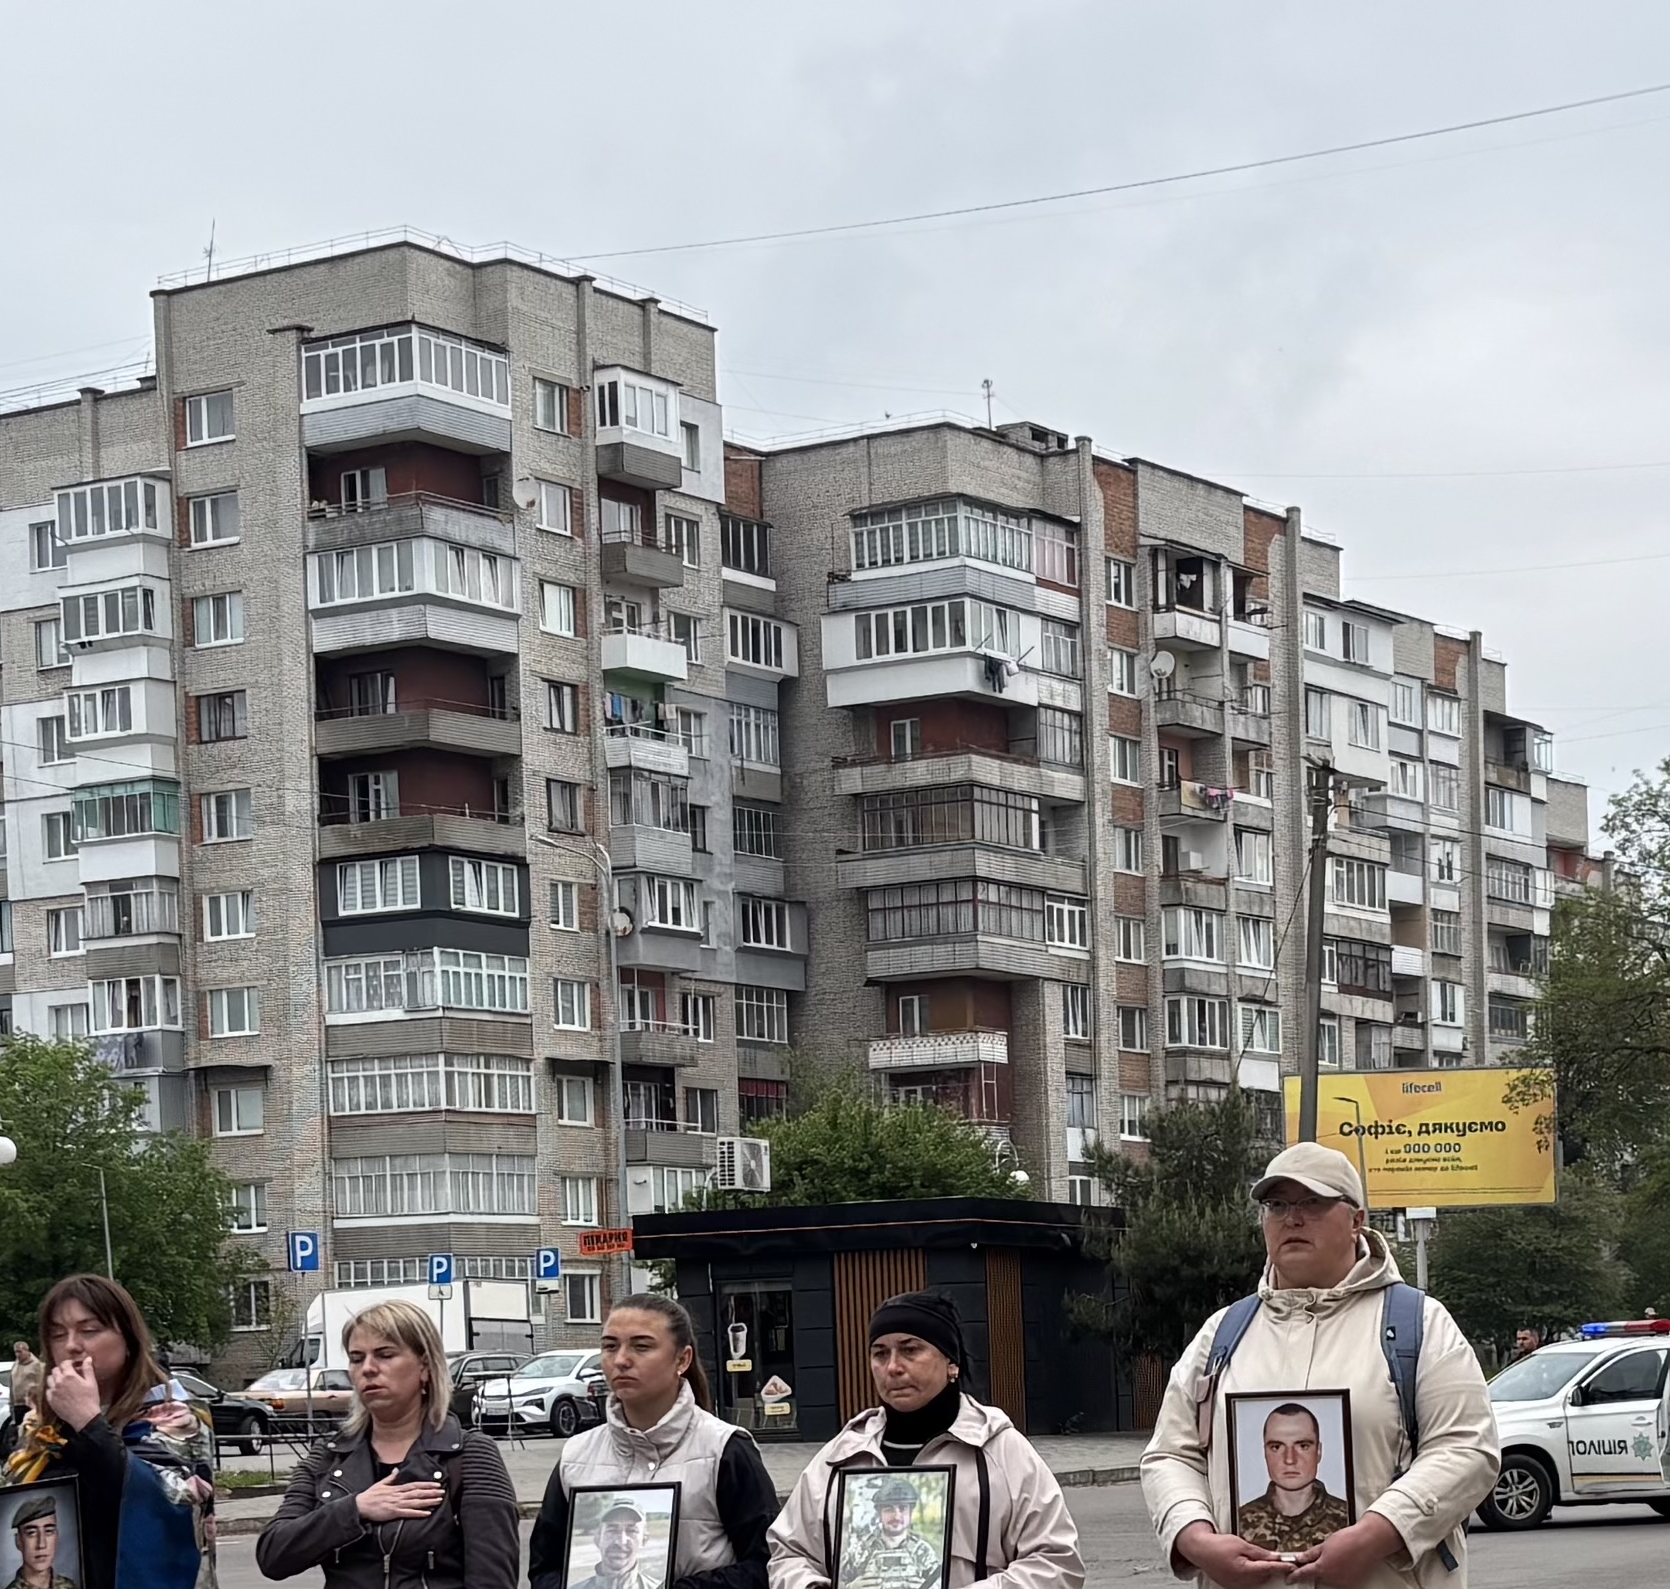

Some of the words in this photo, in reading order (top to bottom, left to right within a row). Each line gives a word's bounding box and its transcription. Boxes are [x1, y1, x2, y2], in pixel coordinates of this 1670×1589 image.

[1339, 1119, 1413, 1140] Софіє,
[1417, 1119, 1506, 1137] дякуємо
[295, 1235, 313, 1268] P
[539, 1251, 555, 1277] P
[432, 1257, 448, 1283] P
